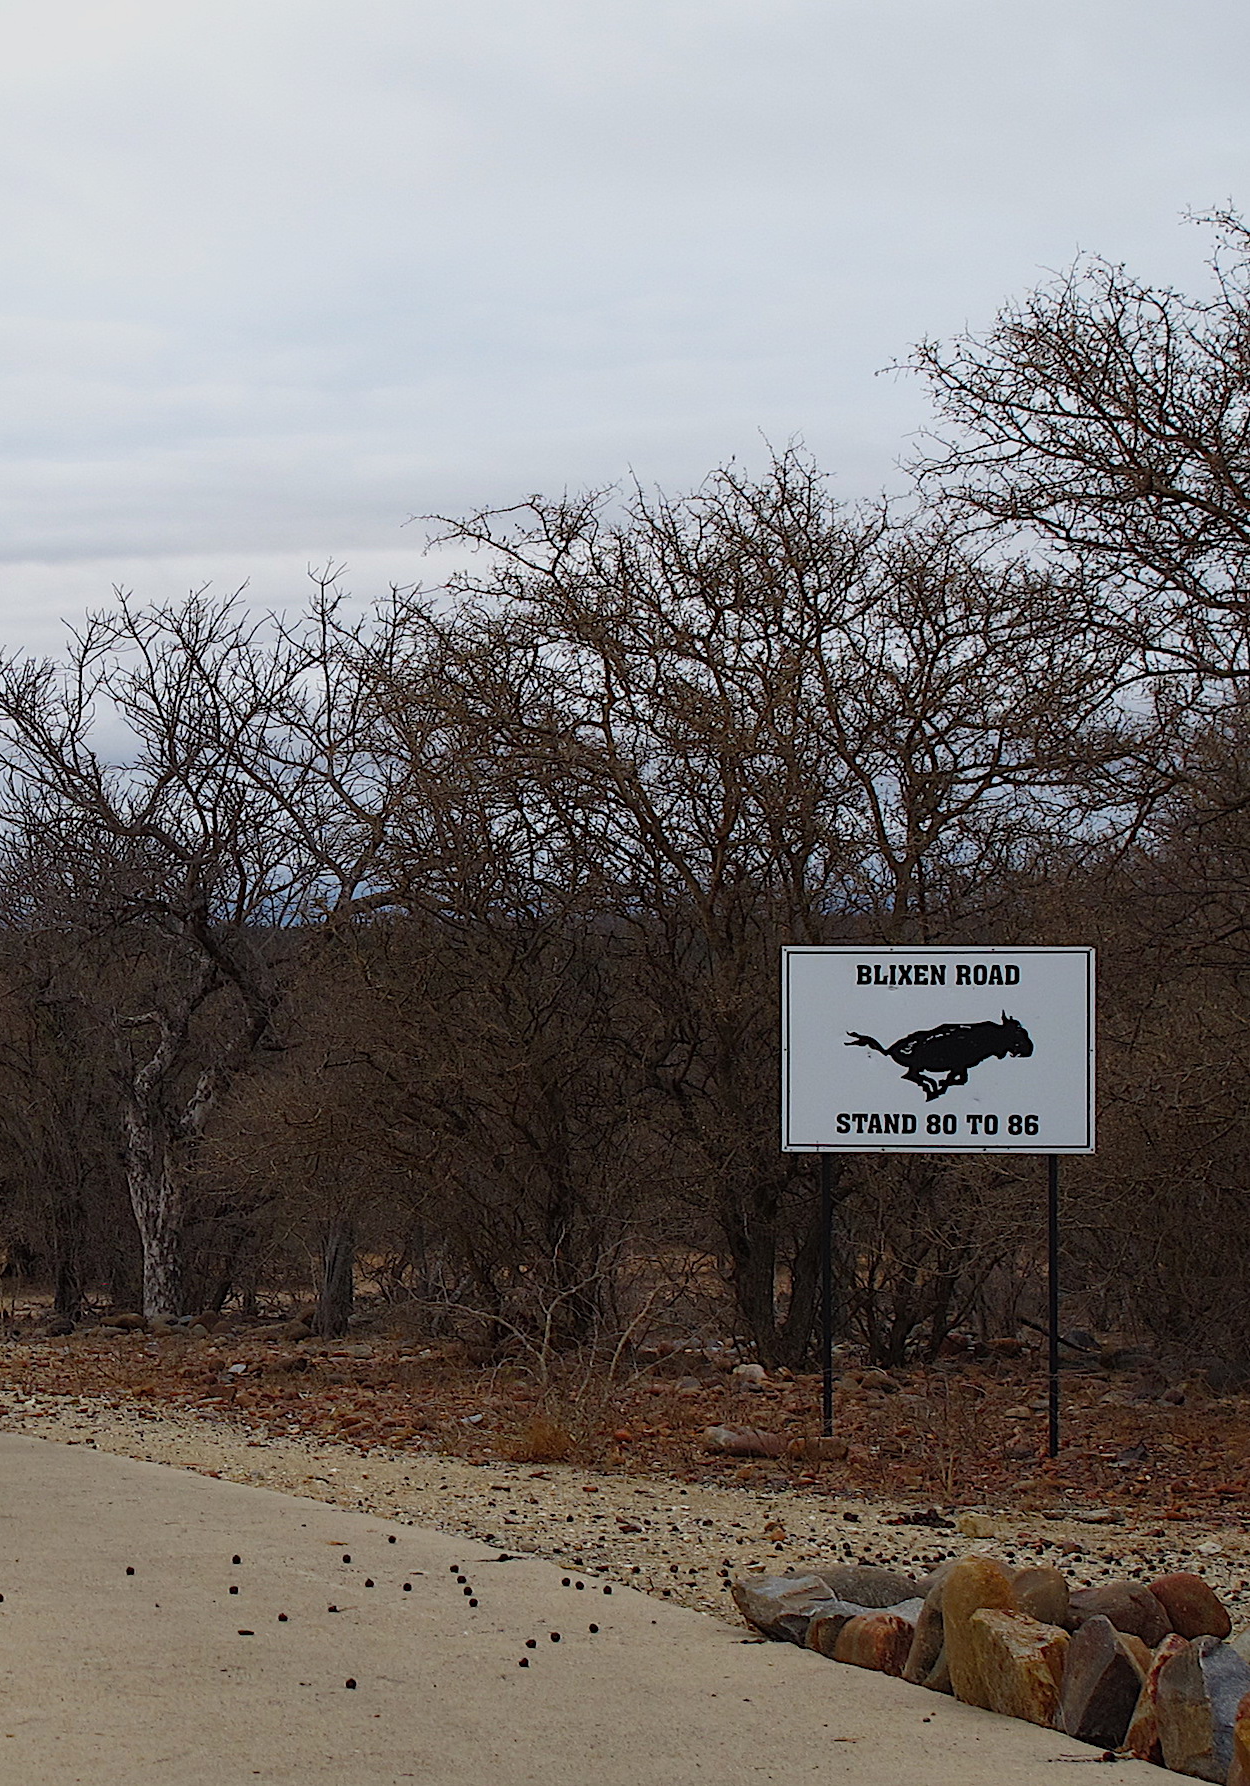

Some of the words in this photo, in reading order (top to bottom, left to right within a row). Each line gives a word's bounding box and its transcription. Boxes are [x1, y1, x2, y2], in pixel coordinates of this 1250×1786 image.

[857, 965, 946, 985] BLIXEN
[956, 965, 1020, 985] ROAD
[837, 1114, 916, 1134] STAND
[927, 1114, 956, 1135] 80
[967, 1114, 998, 1135] TO
[1008, 1115, 1038, 1135] 86
